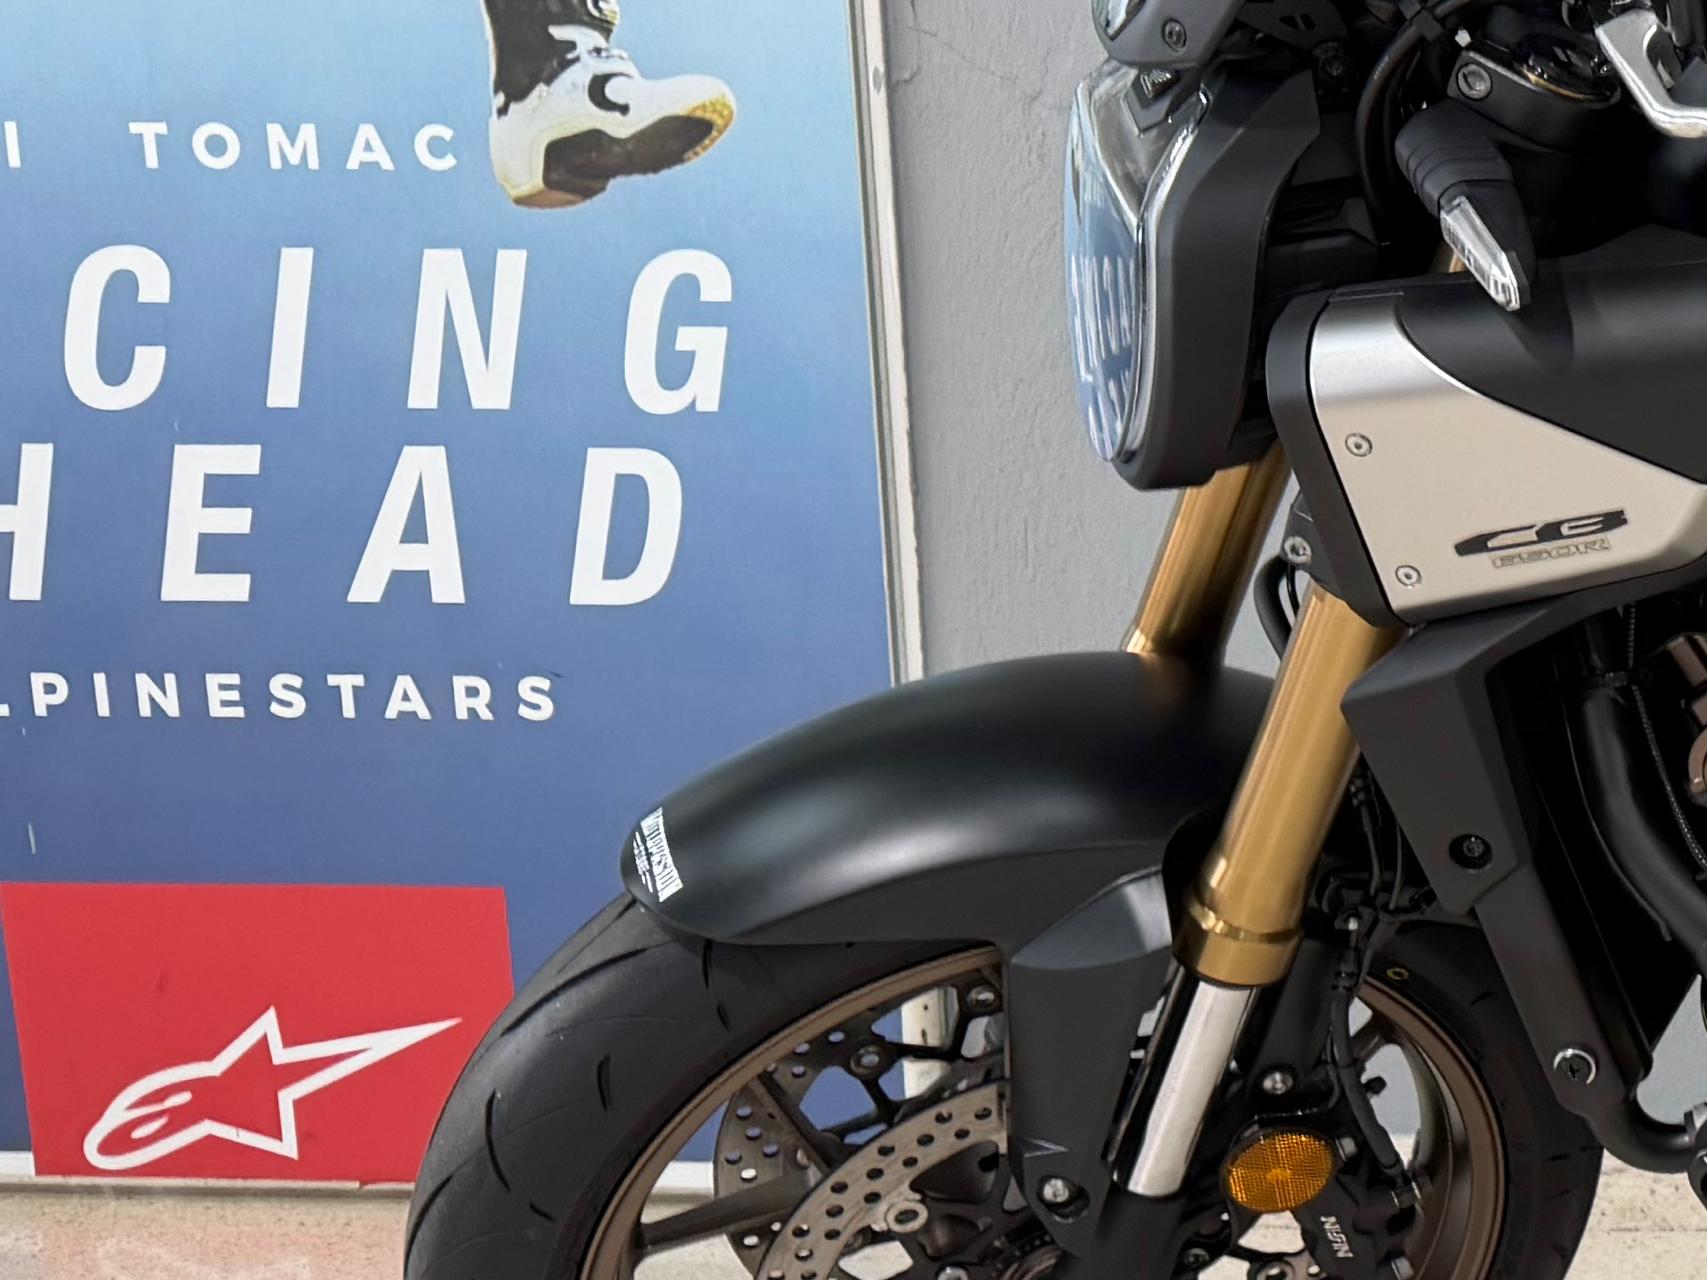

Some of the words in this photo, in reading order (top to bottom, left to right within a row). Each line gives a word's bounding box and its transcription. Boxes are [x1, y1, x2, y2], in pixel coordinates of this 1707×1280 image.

[130, 122, 458, 171] TOMAC
[63, 244, 734, 416] CING
[1454, 507, 1629, 557] CB
[0, 671, 556, 722] PINESTARS
